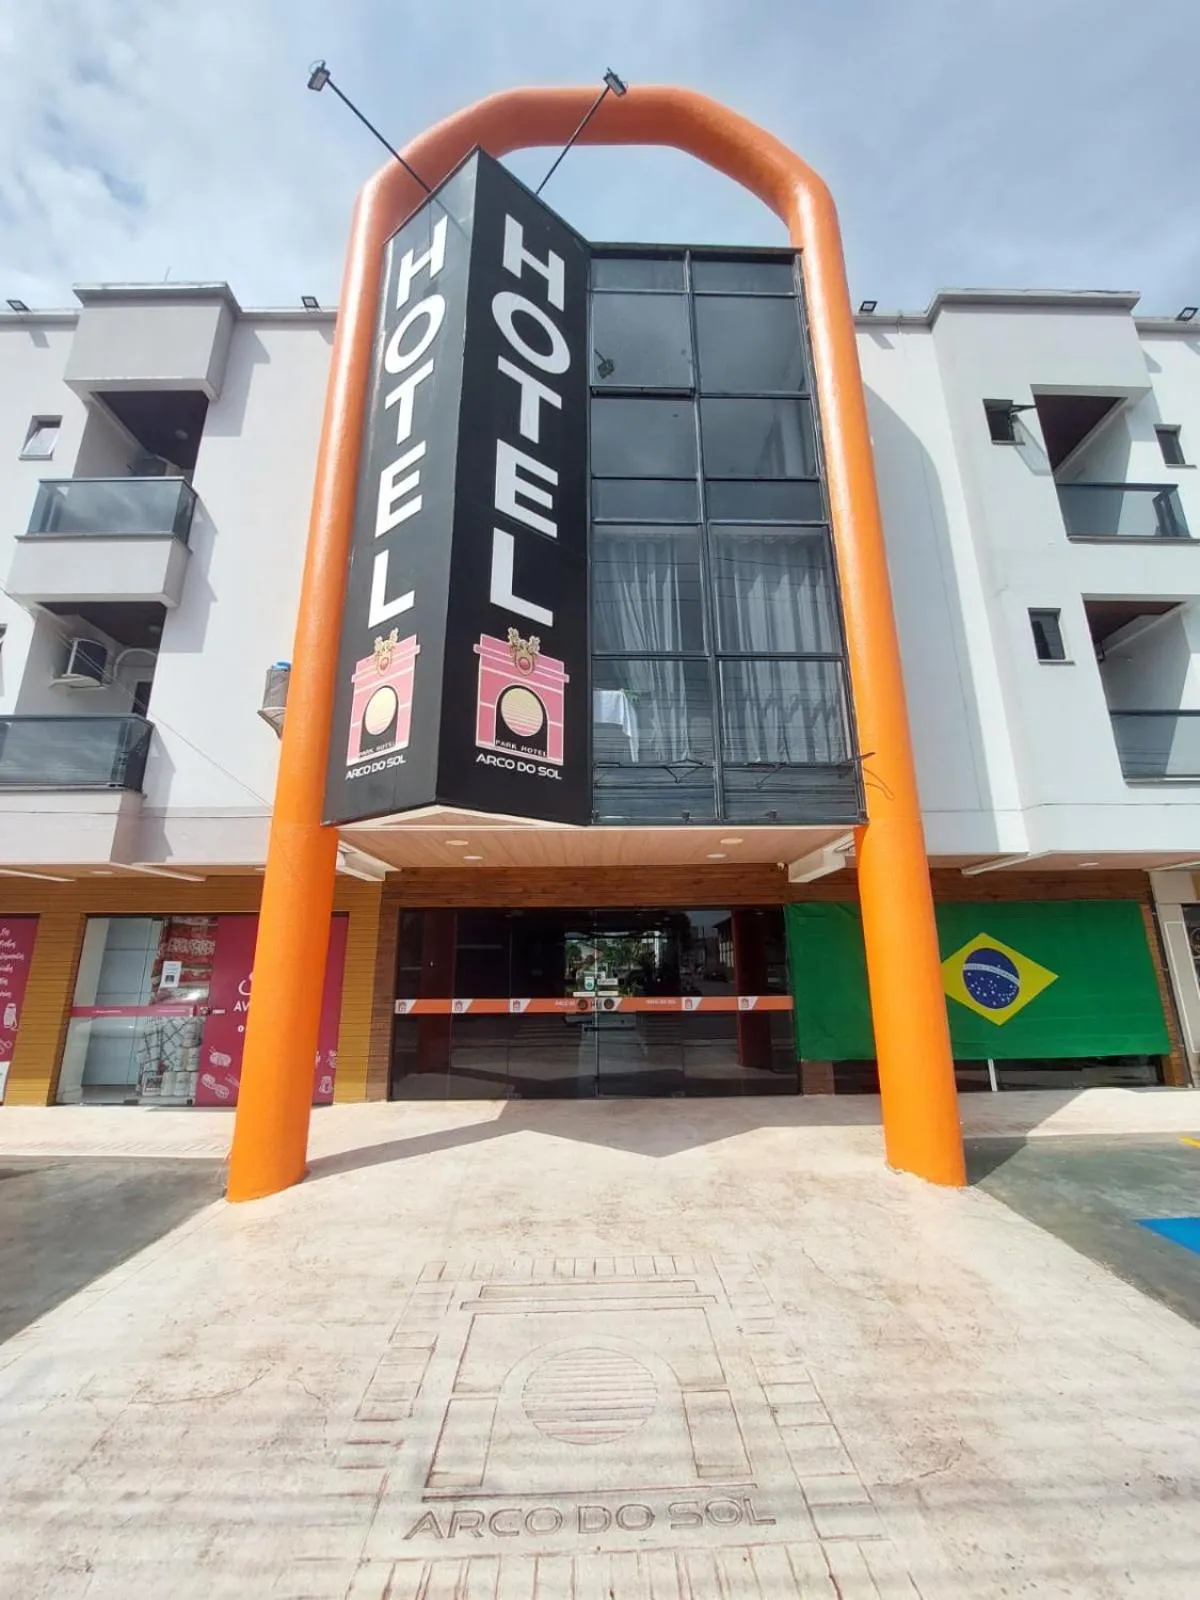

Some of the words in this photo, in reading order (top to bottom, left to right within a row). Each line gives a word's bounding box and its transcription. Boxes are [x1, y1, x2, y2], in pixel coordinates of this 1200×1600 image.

[368, 214, 448, 628] HOTEL
[490, 213, 571, 627] HOTEL
[495, 739, 517, 750] PARK
[345, 765, 371, 780] ARCO
[371, 760, 386, 773] DO
[386, 754, 407, 768] SOL
[476, 753, 515, 769] ARCO
[517, 761, 536, 774] DO
[538, 766, 563, 780] SOL
[402, 1507, 563, 1540] ARCO
[577, 1503, 656, 1534] DO
[667, 1498, 777, 1530] SOL
